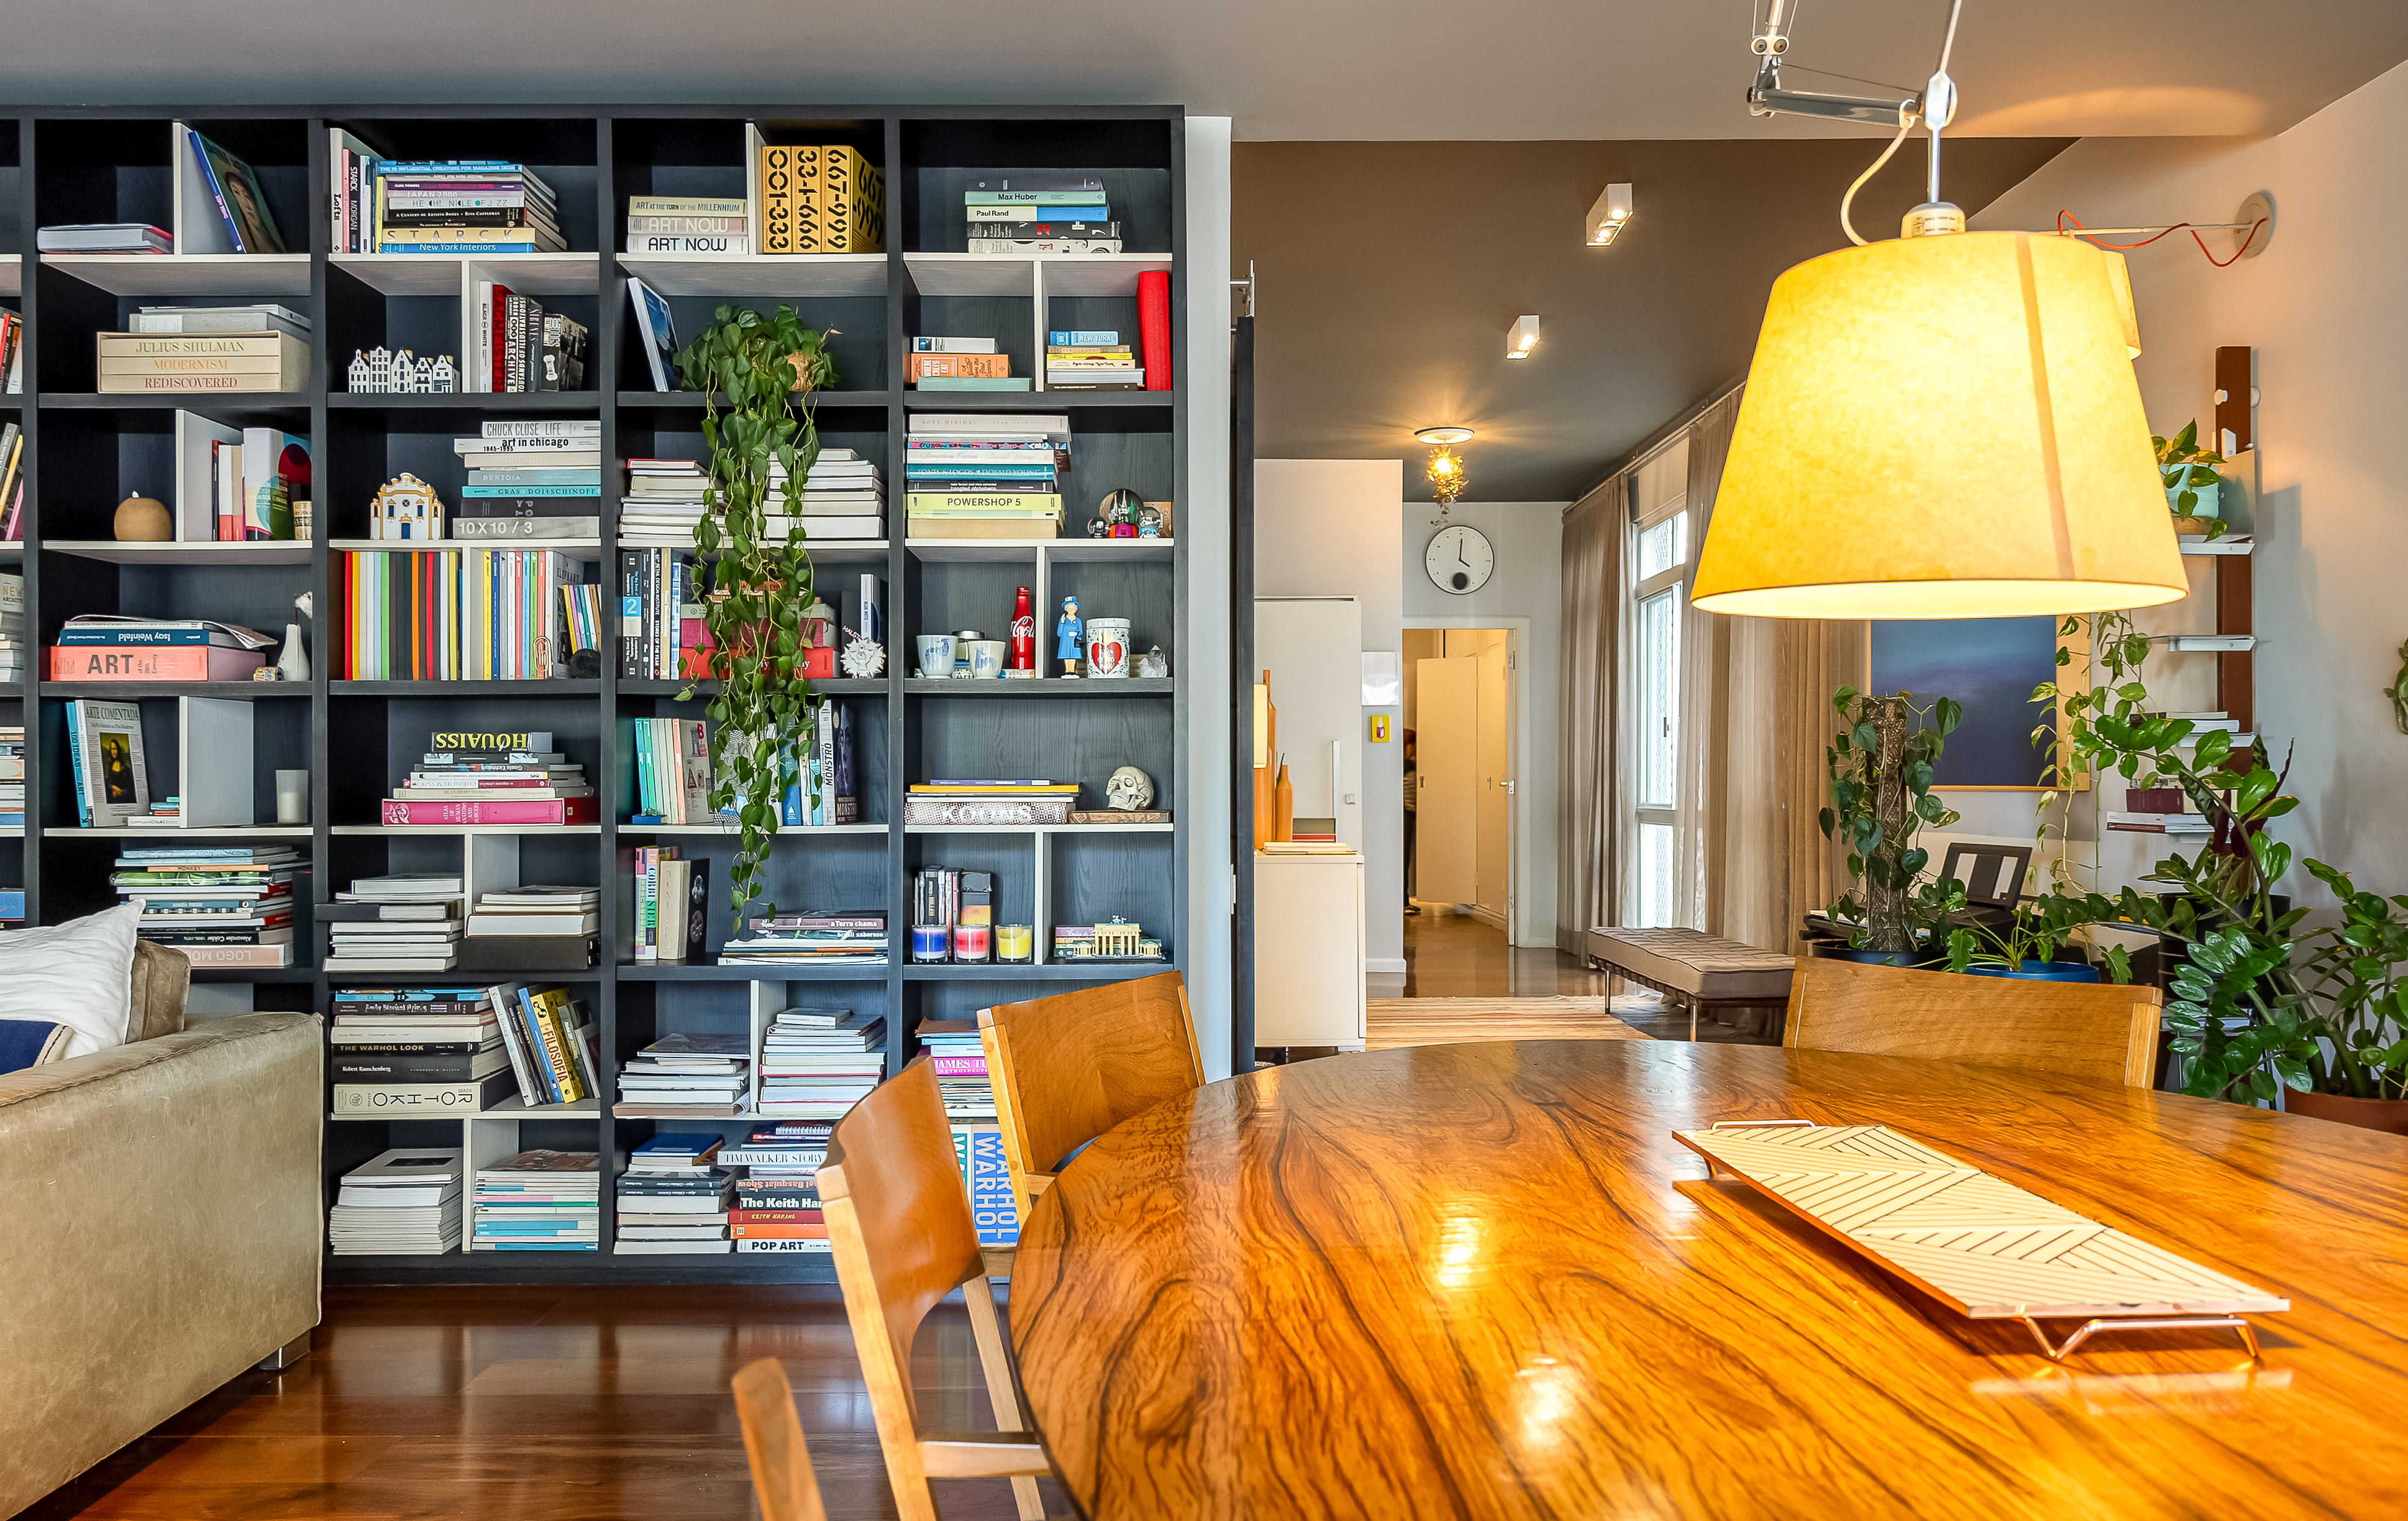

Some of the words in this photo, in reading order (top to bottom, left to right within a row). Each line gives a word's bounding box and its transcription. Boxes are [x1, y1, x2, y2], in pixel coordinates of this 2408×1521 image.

[350, 167, 358, 191] STARCK
[768, 149, 789, 249] 001-333
[798, 149, 819, 249] 334-666
[828, 149, 847, 249] 667-999
[334, 193, 342, 221] Lofts
[636, 201, 649, 209] ART
[697, 203, 740, 212] MILLENNIUM
[648, 217, 682, 232] ART
[685, 217, 729, 234] NOW
[386, 229, 512, 243] STARCK
[440, 244, 458, 252] York
[460, 243, 496, 251] Interiors
[648, 237, 680, 251] ART
[685, 237, 727, 252] NOW
[1079, 333, 1093, 342] NEW
[1095, 332, 1111, 342] YORK
[135, 342, 179, 354] JULIUS
[183, 341, 245, 352] SHULMAN
[153, 359, 228, 370] MODERNISM
[508, 341, 516, 385] ARCHIVE
[145, 376, 237, 388] REDISCOVERED
[486, 424, 513, 437] CHUCK
[515, 423, 539, 436] CLOSE
[545, 422, 562, 436] LIFE
[501, 438, 516, 447] art
[518, 437, 527, 447] in
[529, 437, 569, 449] chicago
[947, 498, 1012, 506] POWERSHOP
[1015, 498, 1021, 506] 5
[524, 522, 533, 534] 3
[626, 598, 637, 614] 2
[118, 633, 153, 641] Weinfeld
[155, 632, 170, 641] Isay
[87, 654, 134, 674] ART
[86, 706, 101, 721] ARTE
[101, 707, 140, 723] COMENTADA
[436, 733, 527, 749] HOUAISS
[824, 742, 833, 787] MONSTRO
[76, 780, 84, 797] ART
[941, 806, 1032, 821] KOONS
[216, 949, 252, 961] LOGO
[542, 1030, 568, 1083] FILOSOFIA
[358, 1065, 391, 1073] Rauschenberg
[934, 1058, 971, 1069] JAMES
[373, 1091, 473, 1108] ROTHKO
[725, 1154, 744, 1163] TIM
[745, 1154, 788, 1163] WALKER
[791, 1153, 823, 1163] STORY
[738, 1181, 764, 1189] Show
[765, 1181, 804, 1189] Basquiat
[741, 1197, 765, 1208] The
[766, 1197, 800, 1208] Keith
[801, 1198, 823, 1208] Har
[752, 1241, 777, 1251] POP
[780, 1241, 805, 1251] ART
